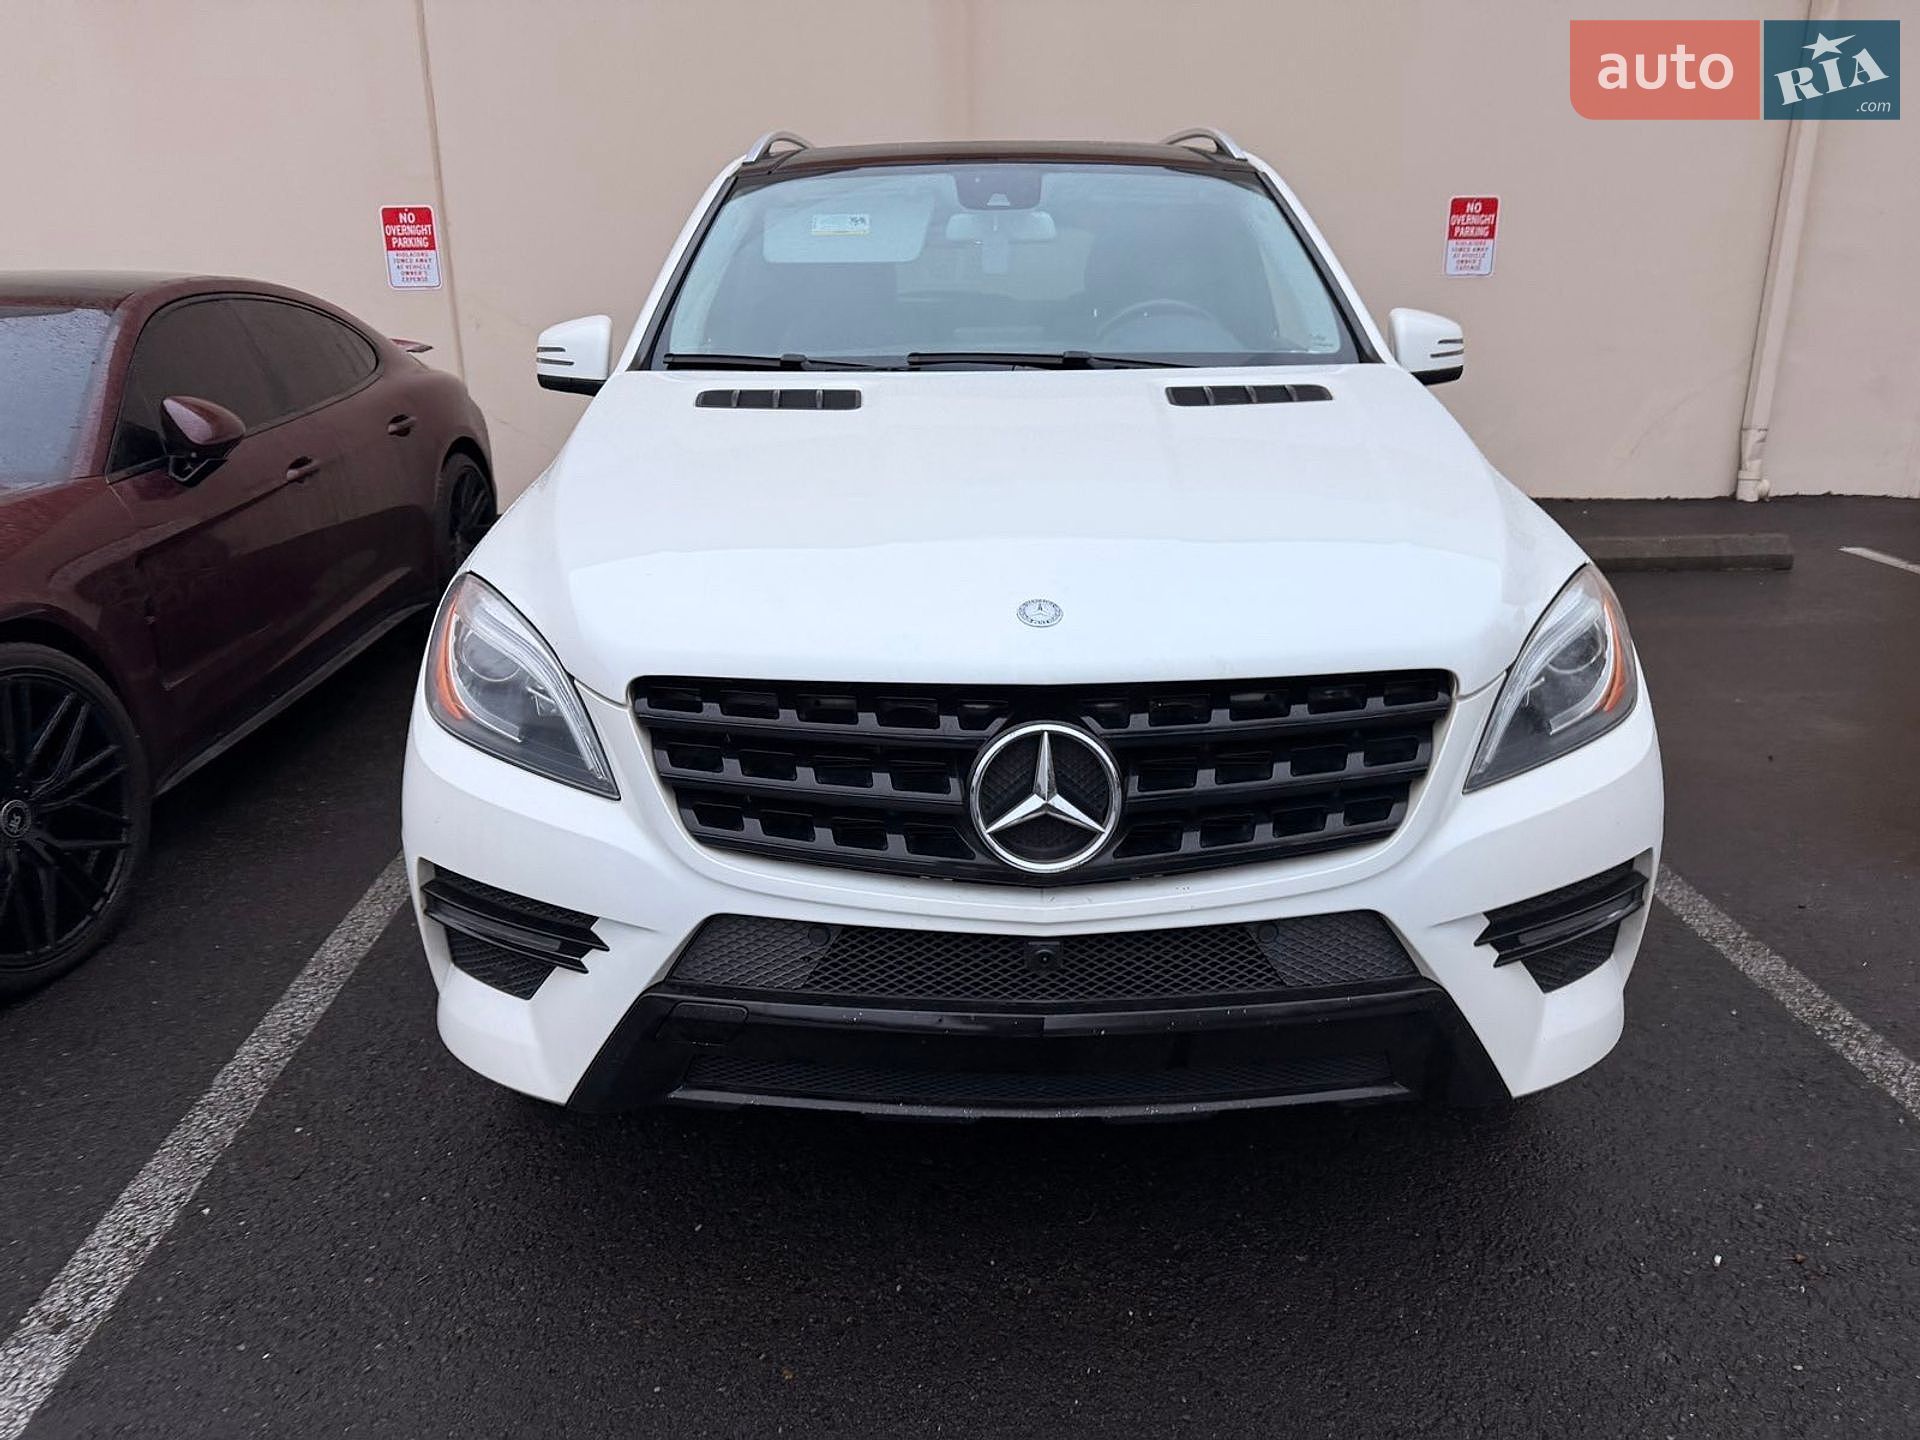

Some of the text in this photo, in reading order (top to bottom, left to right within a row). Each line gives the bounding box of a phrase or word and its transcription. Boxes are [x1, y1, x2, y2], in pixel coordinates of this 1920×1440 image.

[1465, 201, 1483, 214] NO
[399, 212, 416, 223] NO
[1450, 213, 1496, 226] OVERNIGHT
[385, 224, 432, 236] OVERNIGHT
[1453, 226, 1490, 237] PARKING
[391, 237, 429, 248] PARKING
